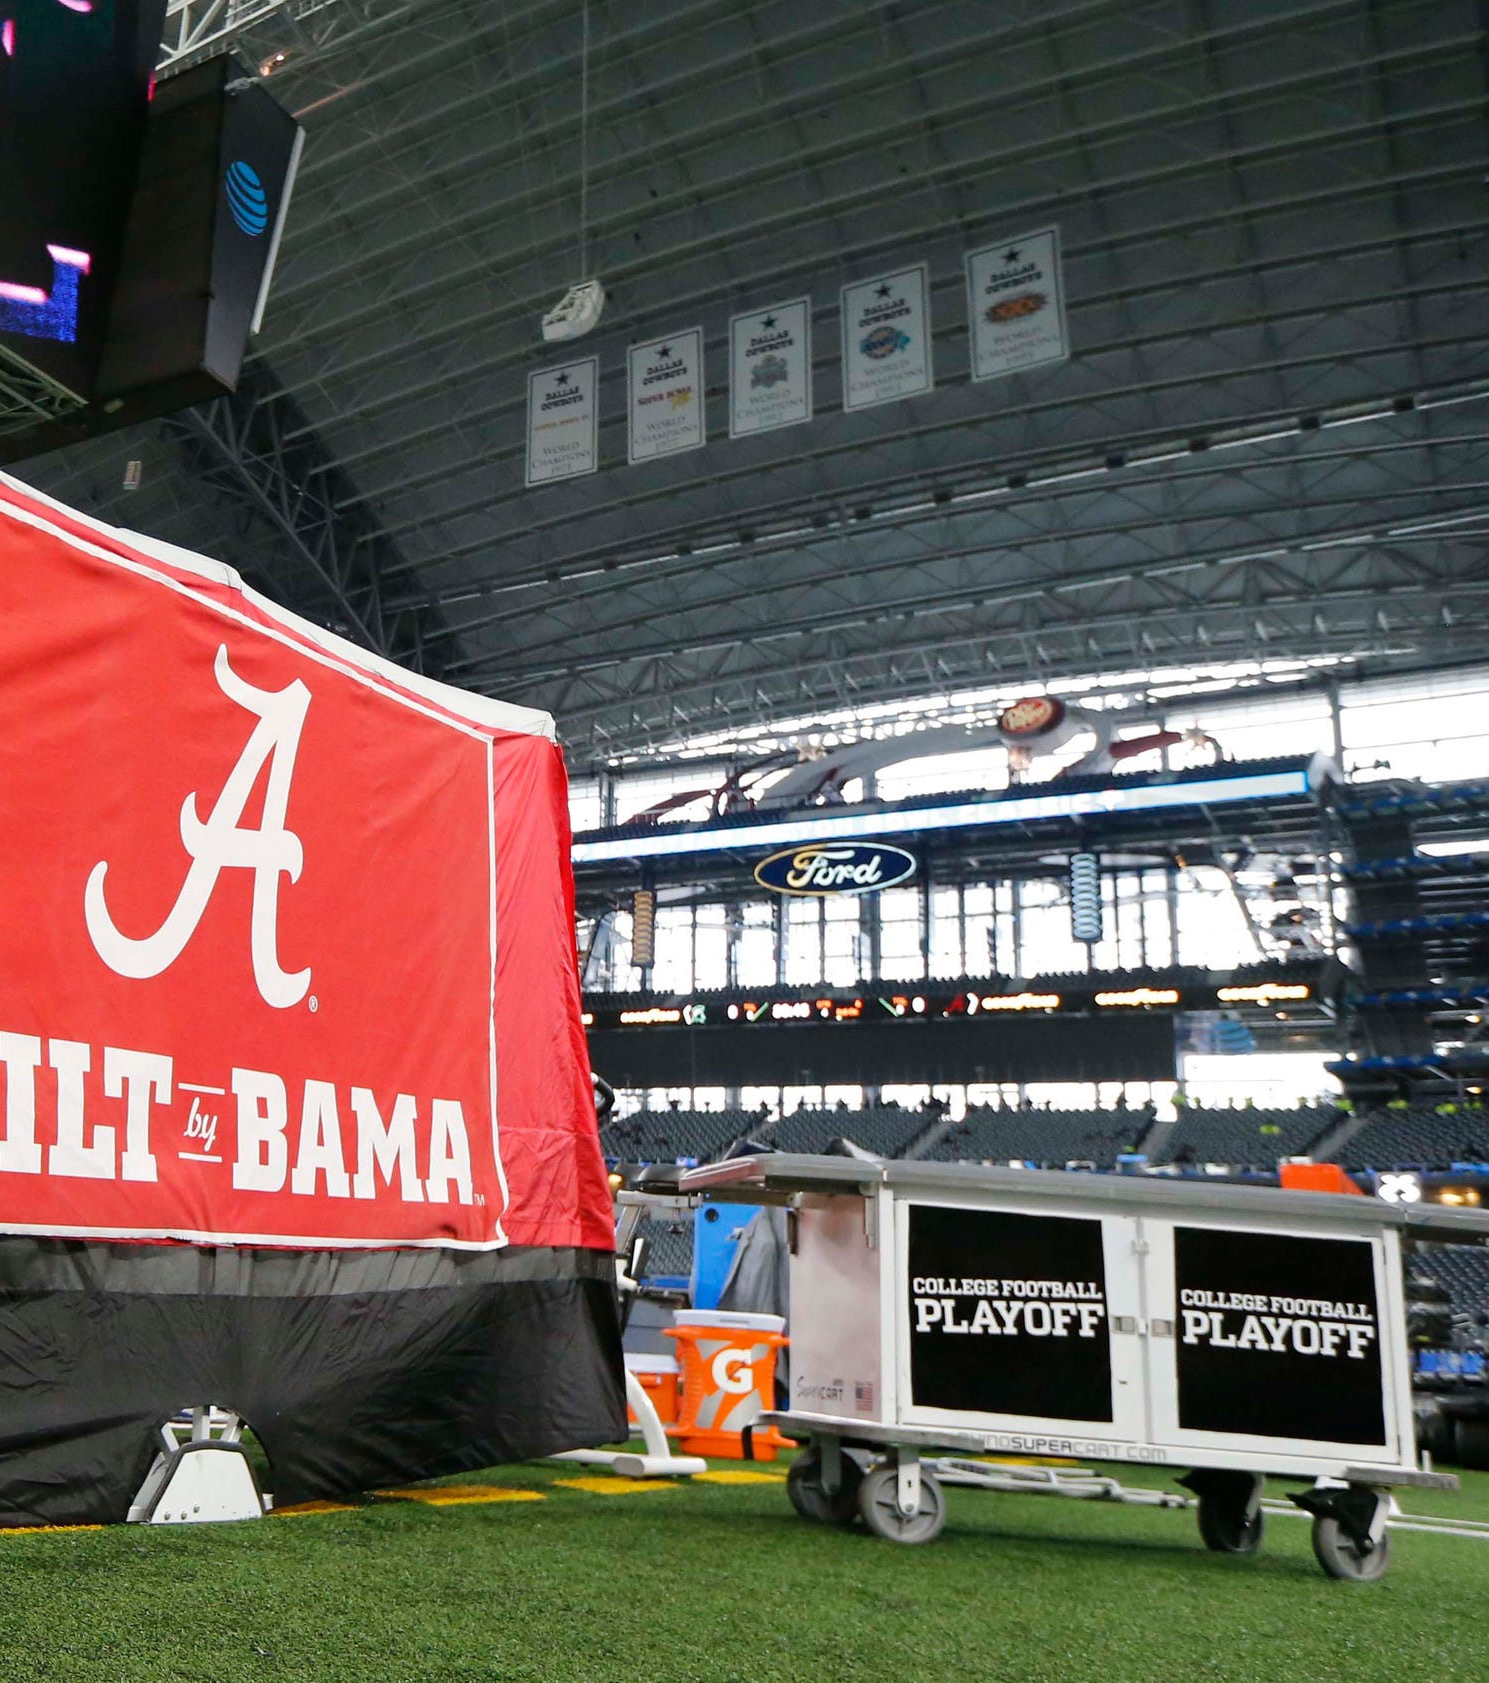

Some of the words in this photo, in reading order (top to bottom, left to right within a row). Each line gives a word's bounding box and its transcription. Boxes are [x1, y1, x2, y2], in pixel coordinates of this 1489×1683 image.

[745, 338, 794, 357] COWBOYS
[750, 329, 789, 347] DALLAS
[642, 366, 688, 386] COWBOYS
[646, 359, 683, 376] DALLAS
[541, 394, 584, 411] COWBOYS
[545, 385, 580, 401] DALLAS
[786, 850, 882, 888] Ford
[183, 1096, 218, 1152] by
[231, 1067, 474, 1205] BAMA
[912, 1277, 999, 1296] COLLEGE
[1001, 1280, 1103, 1299] FOOTBALL
[1180, 1288, 1268, 1313] COLLEGE
[1269, 1296, 1374, 1322] FOOTBALL
[913, 1298, 1105, 1338] PLAYOFF
[1181, 1309, 1375, 1359] PLAYOFF
[712, 1348, 753, 1394] G
